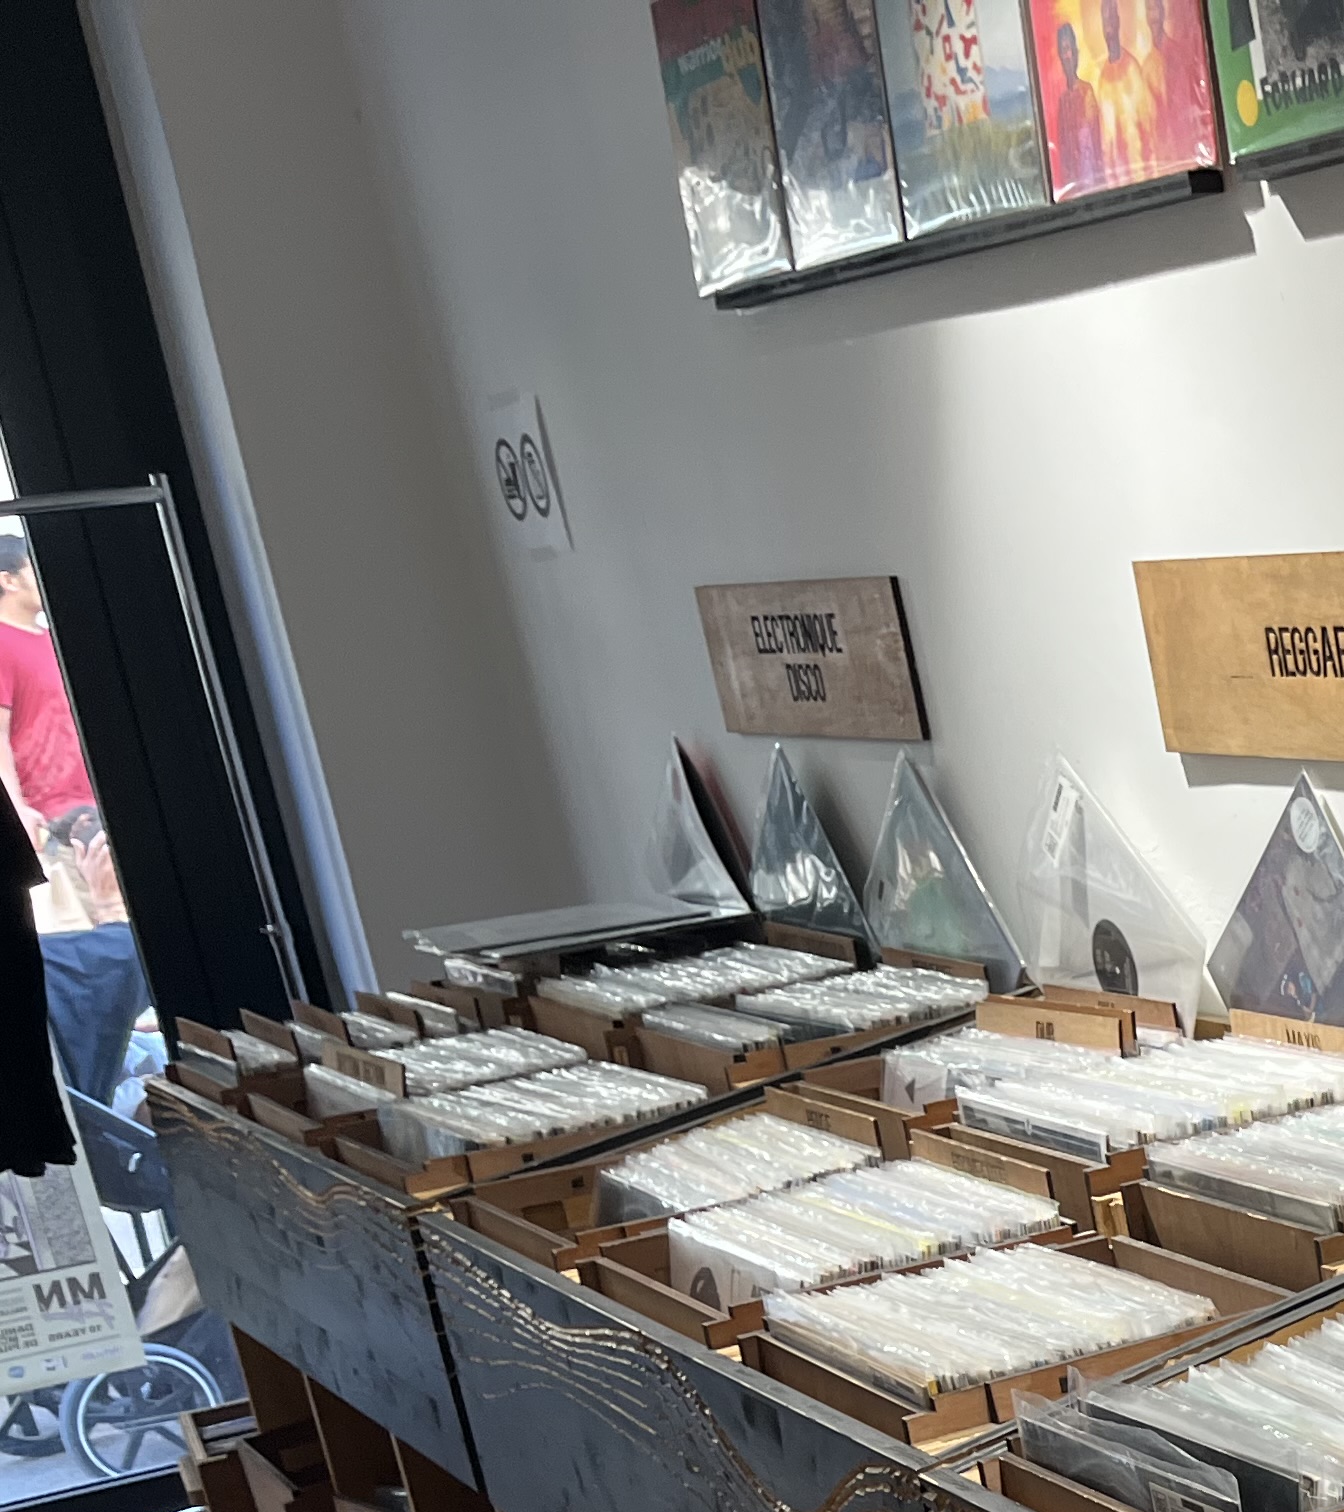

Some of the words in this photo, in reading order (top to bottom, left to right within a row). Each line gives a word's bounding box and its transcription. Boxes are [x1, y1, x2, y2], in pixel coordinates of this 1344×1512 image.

[1259, 56, 1344, 117] FORWARD
[751, 611, 843, 658] ELECTRONIQUE
[785, 663, 827, 702] DISCO
